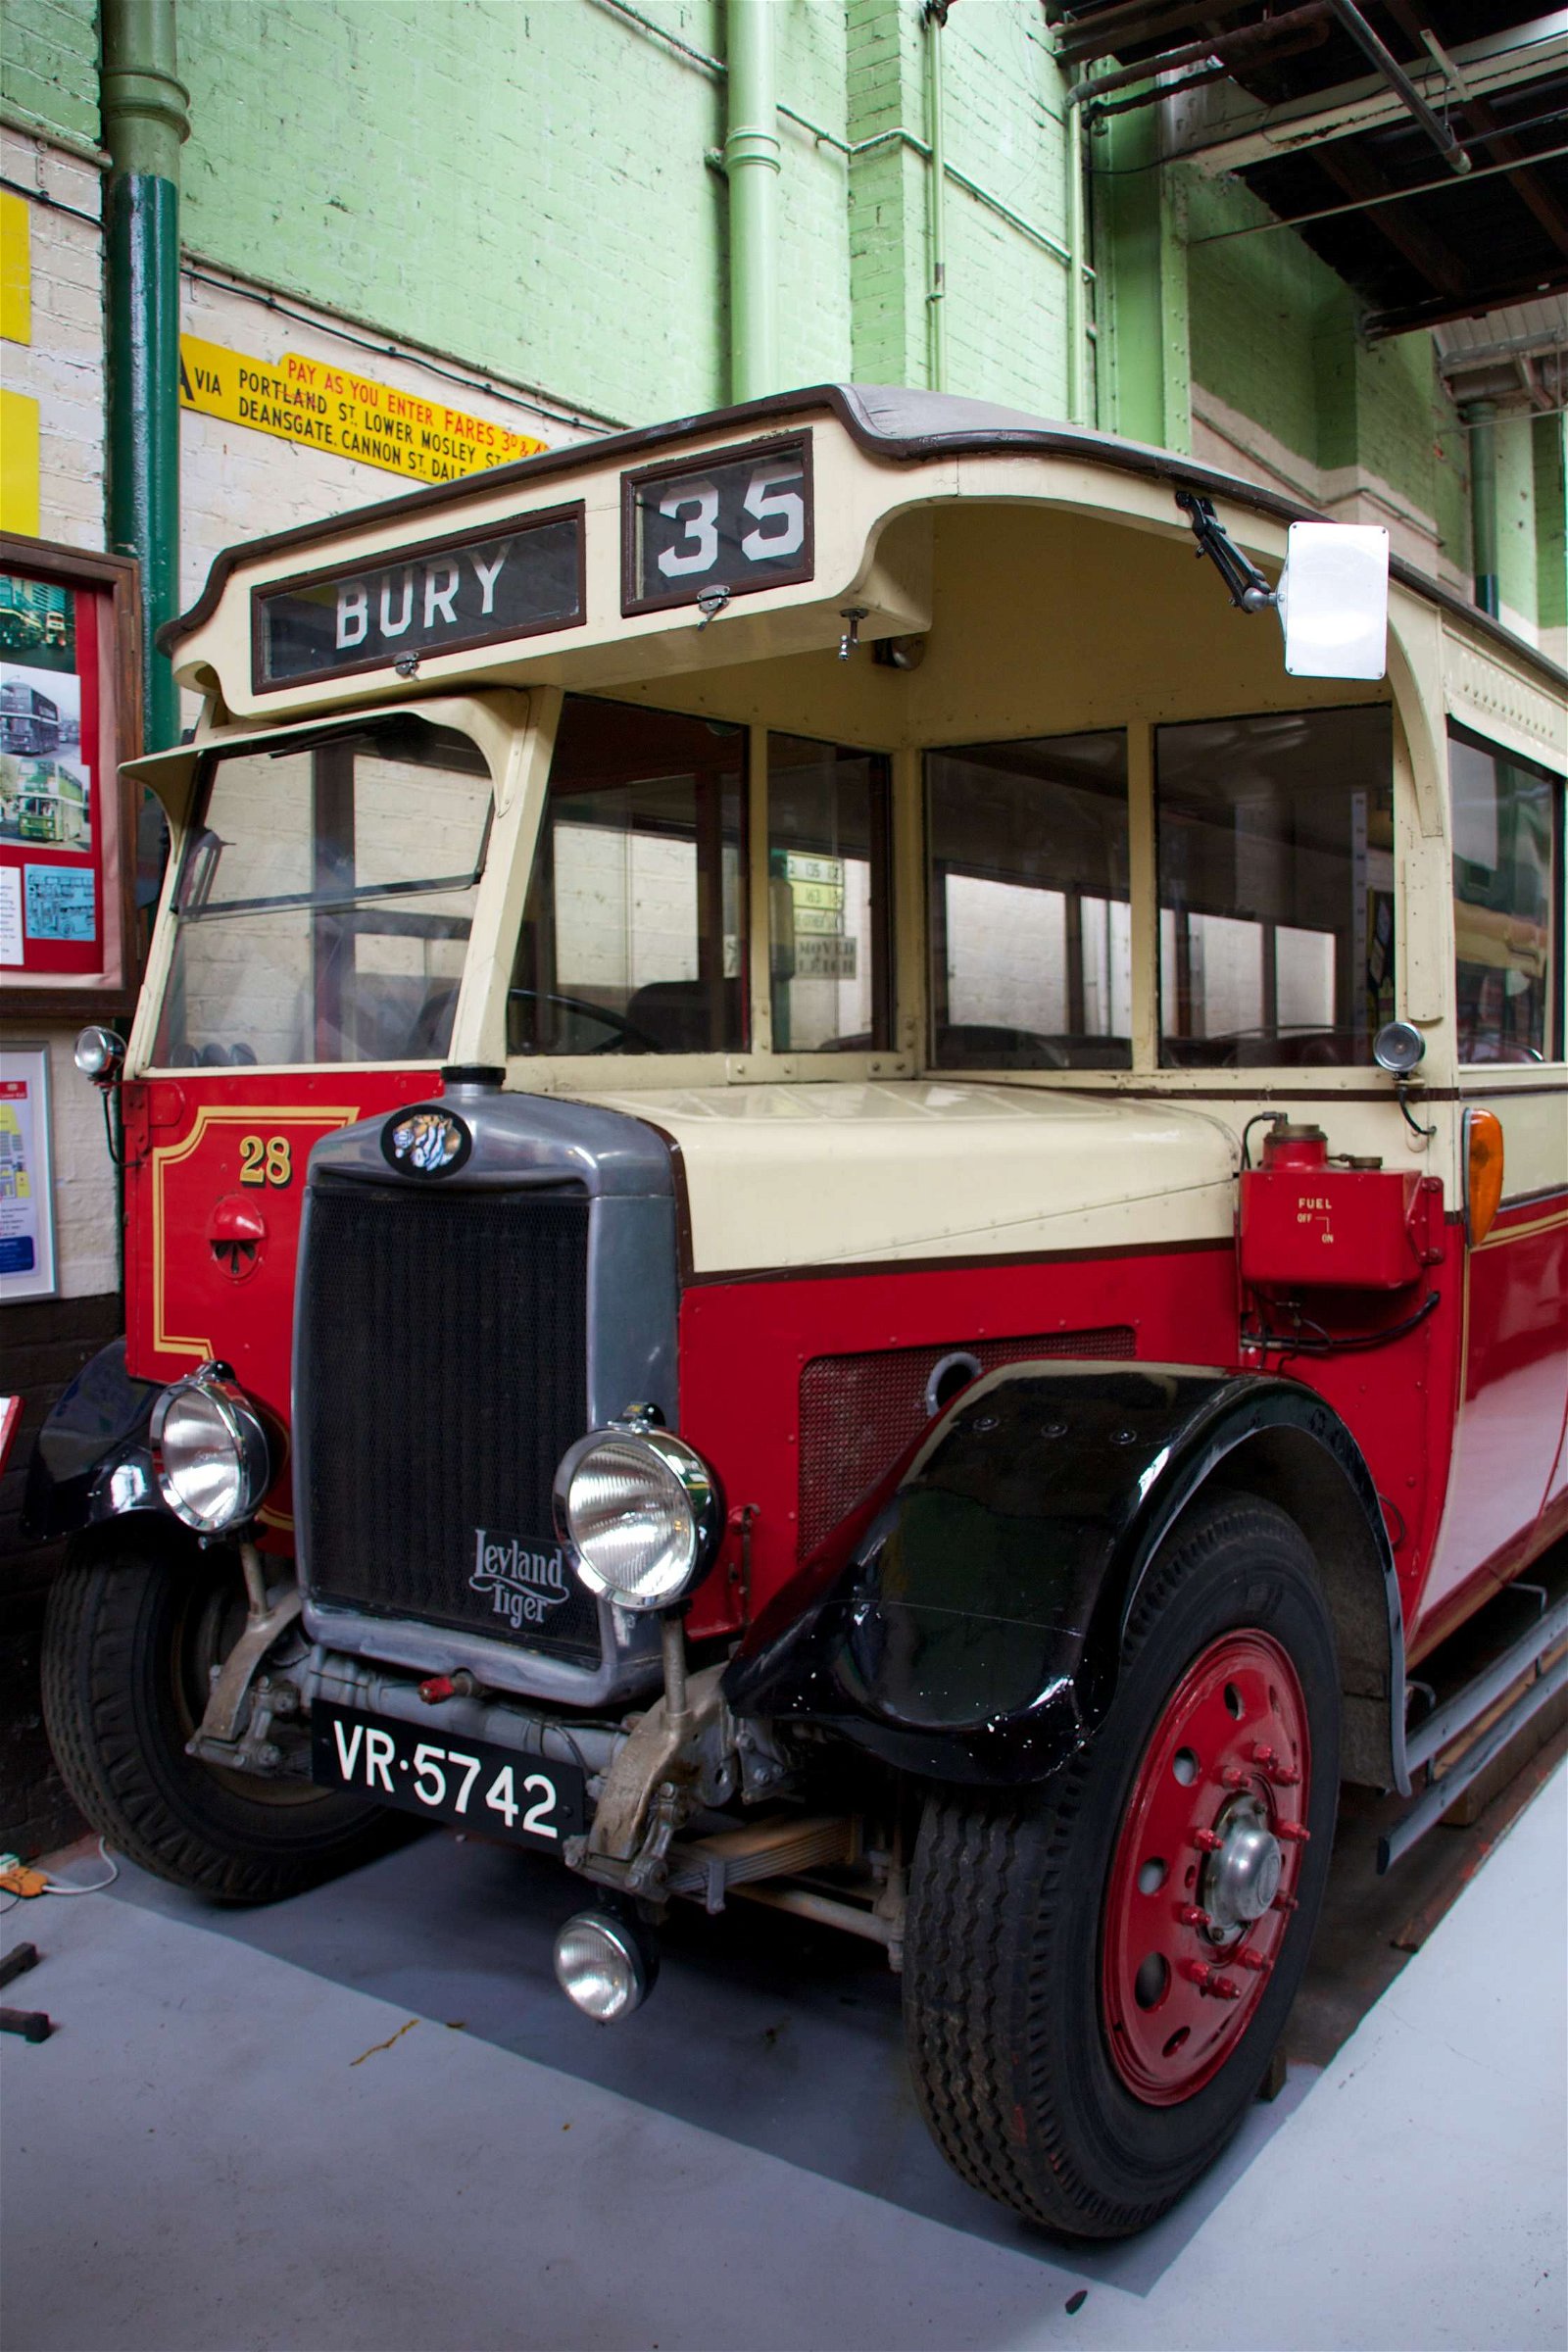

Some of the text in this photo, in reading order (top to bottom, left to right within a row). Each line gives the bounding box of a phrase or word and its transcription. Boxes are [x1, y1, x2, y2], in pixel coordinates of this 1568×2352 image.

[194, 368, 222, 396] VIA
[239, 368, 327, 414] PORTLAND
[365, 412, 414, 444] LOWER
[421, 430, 475, 464] MOSLEY
[288, 359, 317, 385] PAY
[324, 372, 343, 395] AS
[349, 380, 378, 407] YOU
[388, 394, 433, 426] ENTER
[445, 411, 494, 446] FARES
[342, 430, 401, 466] CANNON
[658, 459, 804, 578] 35
[335, 543, 512, 650] BURY
[239, 1136, 291, 1186] 28
[1297, 1212, 1312, 1223] OFF
[1298, 1198, 1332, 1209] FUEL
[1321, 1233, 1334, 1244] ON
[473, 1529, 564, 1589] Leyland
[492, 1581, 547, 1629] Tiger
